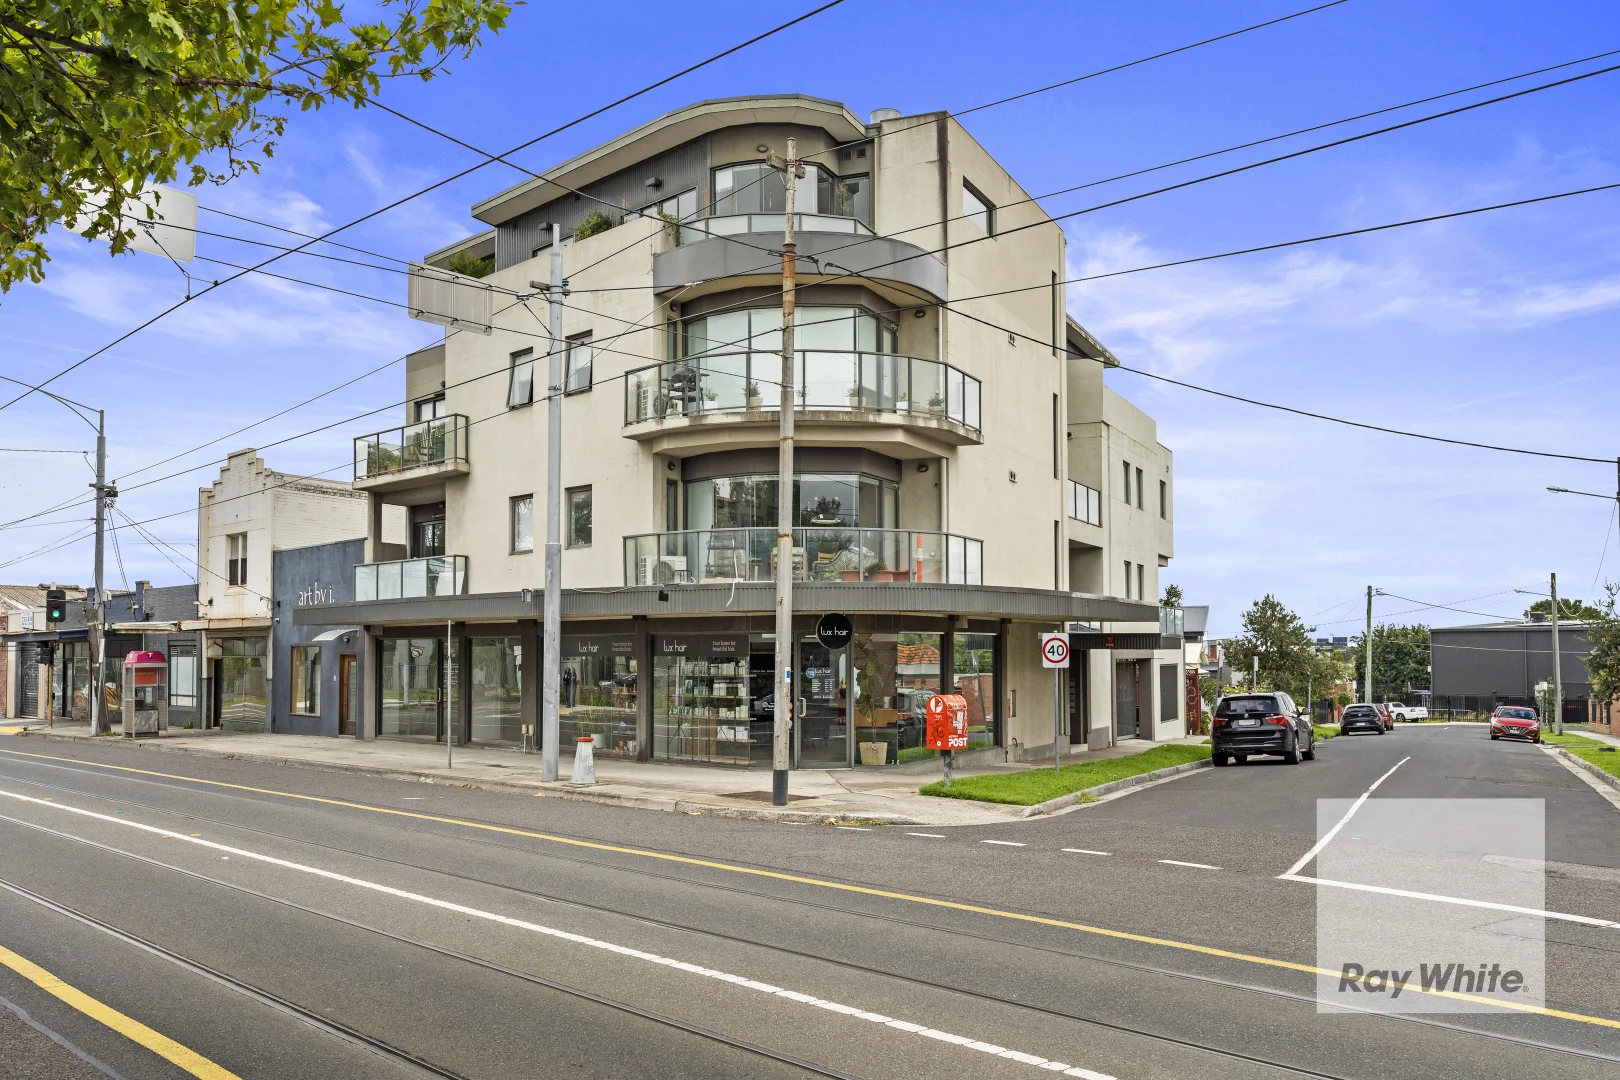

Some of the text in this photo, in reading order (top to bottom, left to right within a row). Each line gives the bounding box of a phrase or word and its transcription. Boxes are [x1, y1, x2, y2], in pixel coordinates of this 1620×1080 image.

[298, 586, 313, 606] art
[821, 626, 849, 636] lux hair
[578, 641, 600, 653] lux hair
[663, 639, 688, 652] lux hair
[1047, 644, 1065, 656] 40
[948, 737, 968, 748] POST
